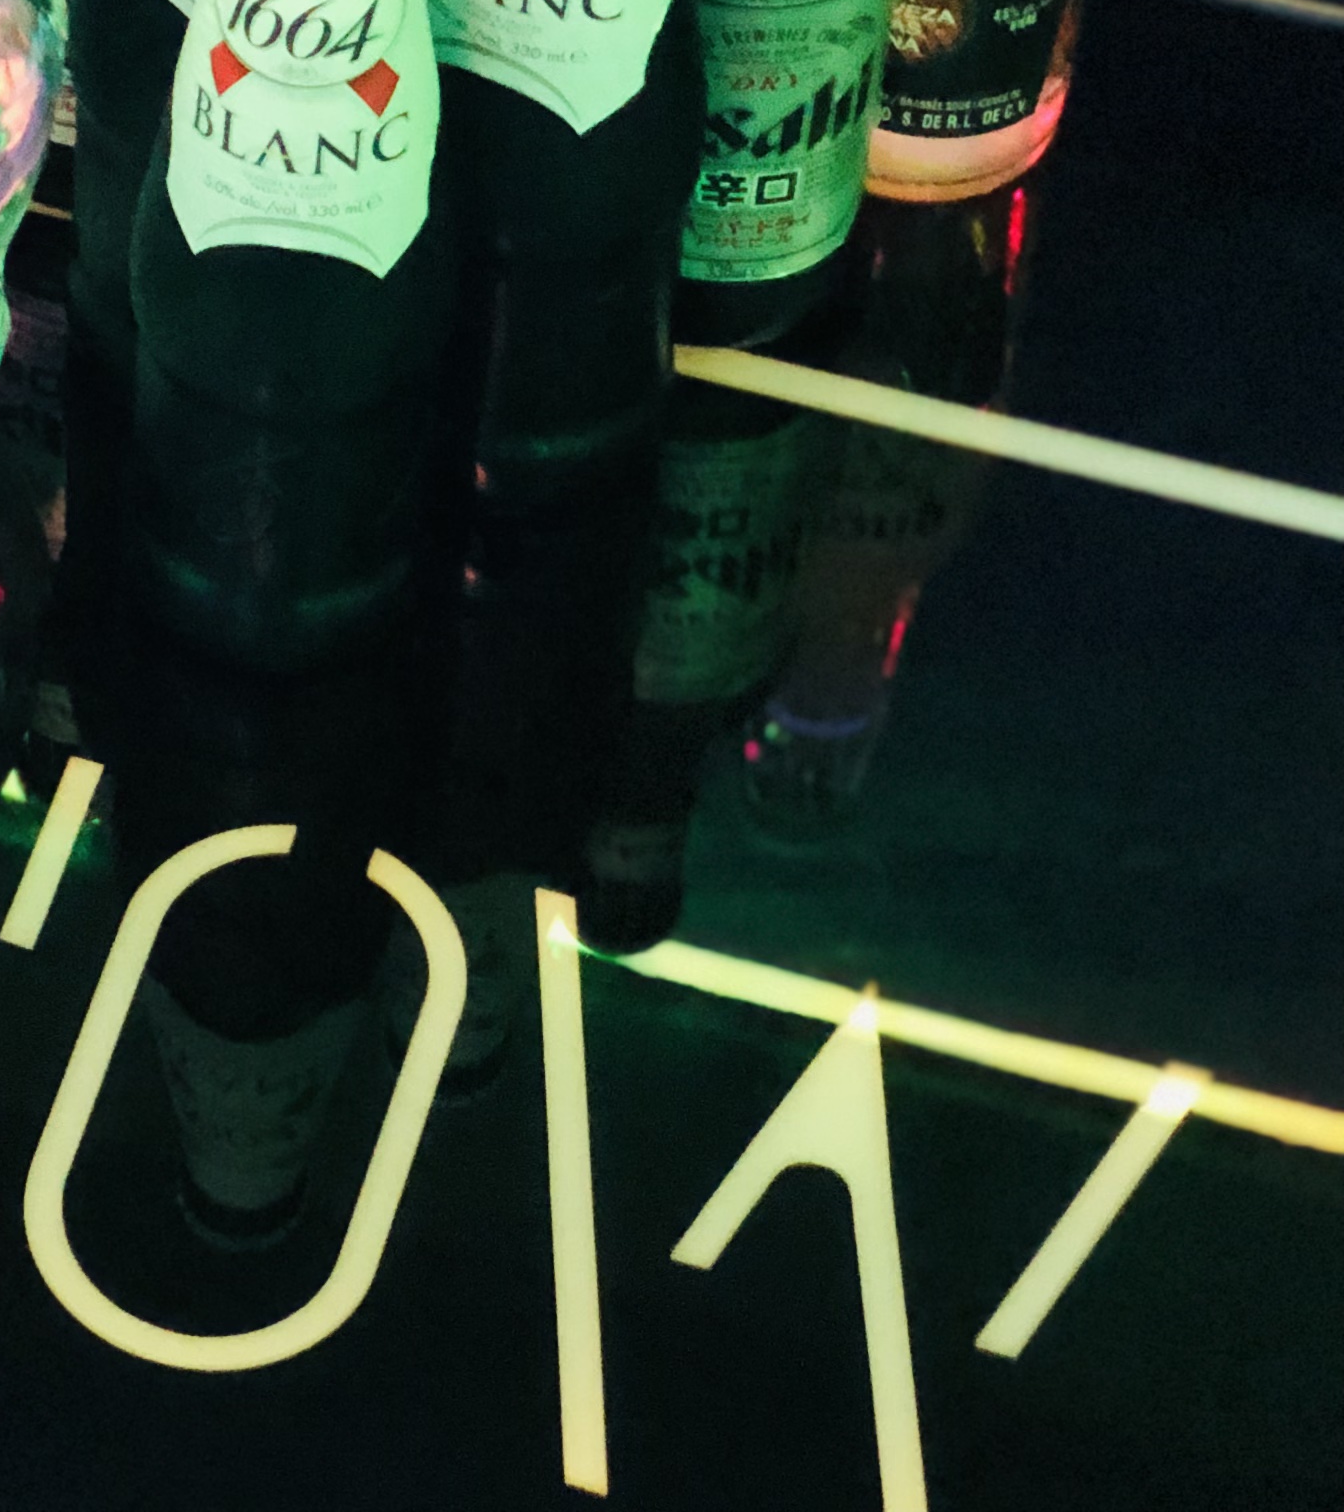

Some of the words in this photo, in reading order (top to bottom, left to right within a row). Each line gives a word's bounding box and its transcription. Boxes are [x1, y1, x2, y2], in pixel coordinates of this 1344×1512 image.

[193, 85, 409, 176] BLANC
[702, 52, 875, 159] sahi
[700, 171, 799, 208] 辛口
